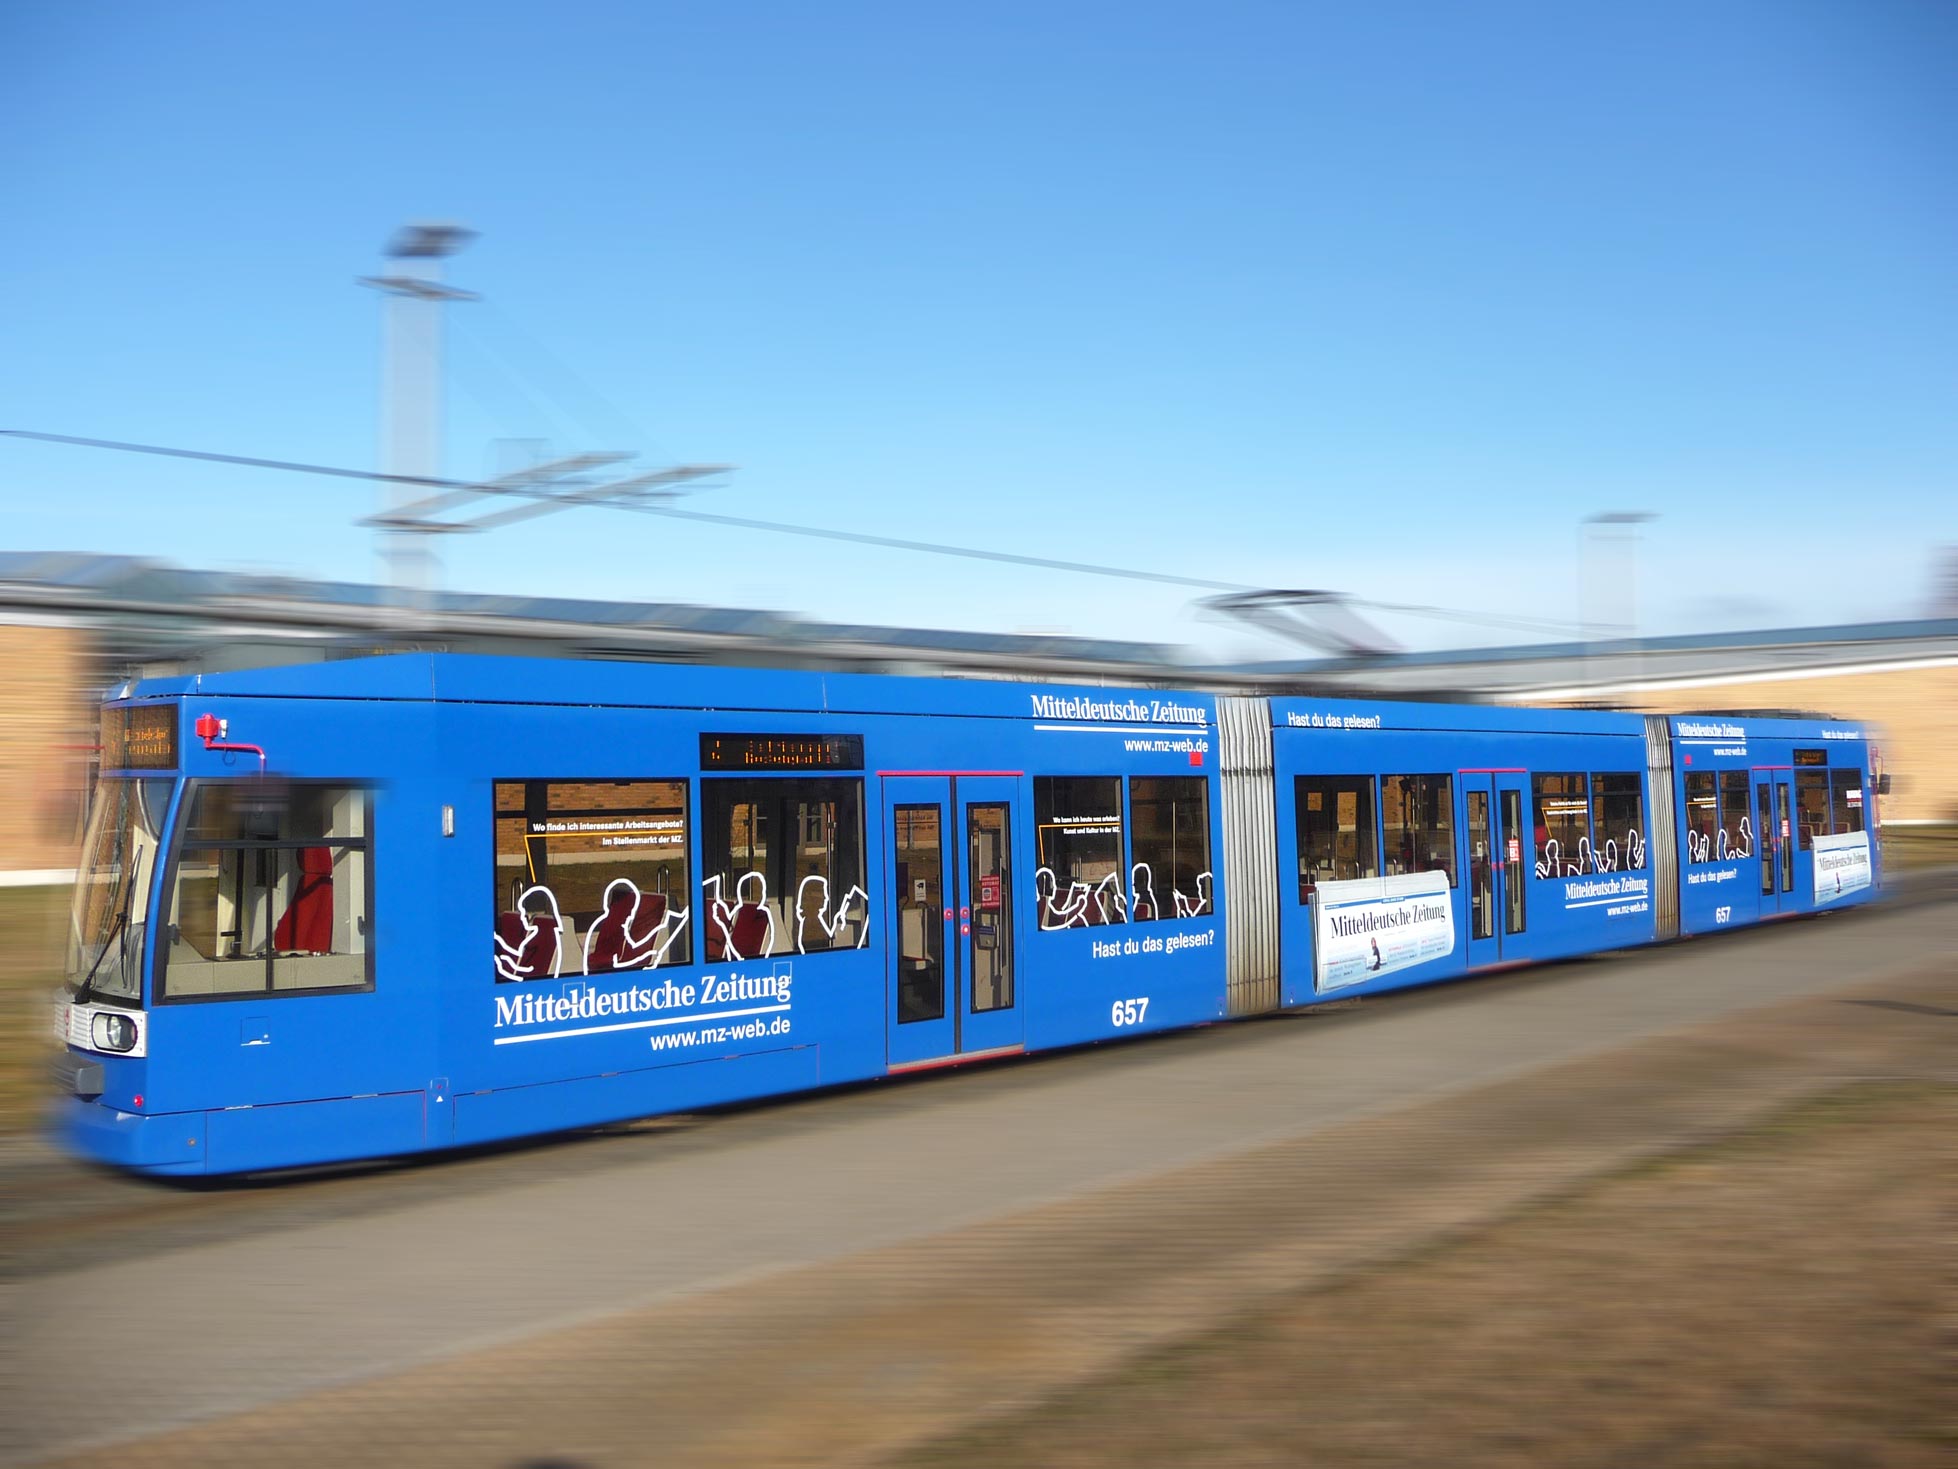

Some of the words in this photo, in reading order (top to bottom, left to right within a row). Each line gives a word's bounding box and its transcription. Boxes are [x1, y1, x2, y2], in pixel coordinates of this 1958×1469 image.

[1030, 695, 1149, 721] Mitteldeutsche
[1151, 700, 1207, 728] Zeitung
[1287, 711, 1310, 726] Hast
[1312, 712, 1324, 727] du
[1325, 713, 1341, 727] das
[1343, 714, 1380, 731] gelesen?
[1124, 738, 1208, 752] www.mz-web.de
[533, 823, 546, 832] Wo
[546, 822, 566, 831] finde
[567, 821, 579, 830] ich
[579, 821, 624, 830] interessante
[625, 820, 683, 831] Arbeitsangebote?
[602, 837, 612, 845] Im
[613, 836, 657, 845] Stellenmarkt
[658, 835, 670, 844] der
[671, 835, 683, 843] MZ.
[1565, 878, 1620, 900] Mitteldeutsche
[1621, 876, 1648, 894] Zeitung
[1330, 906, 1411, 939] Mitteldeutsche
[1412, 903, 1446, 923] Zeitung
[1716, 906, 1731, 923] 657
[1092, 941, 1121, 959] Hast
[1124, 937, 1139, 955] du
[1142, 935, 1163, 953] das
[1165, 929, 1214, 954] gelesen?
[494, 979, 695, 1027] Mitteldeutsche
[700, 972, 791, 1002] Zeitung
[1112, 997, 1149, 1027] 657
[651, 1016, 791, 1051] www.mz-web.de
